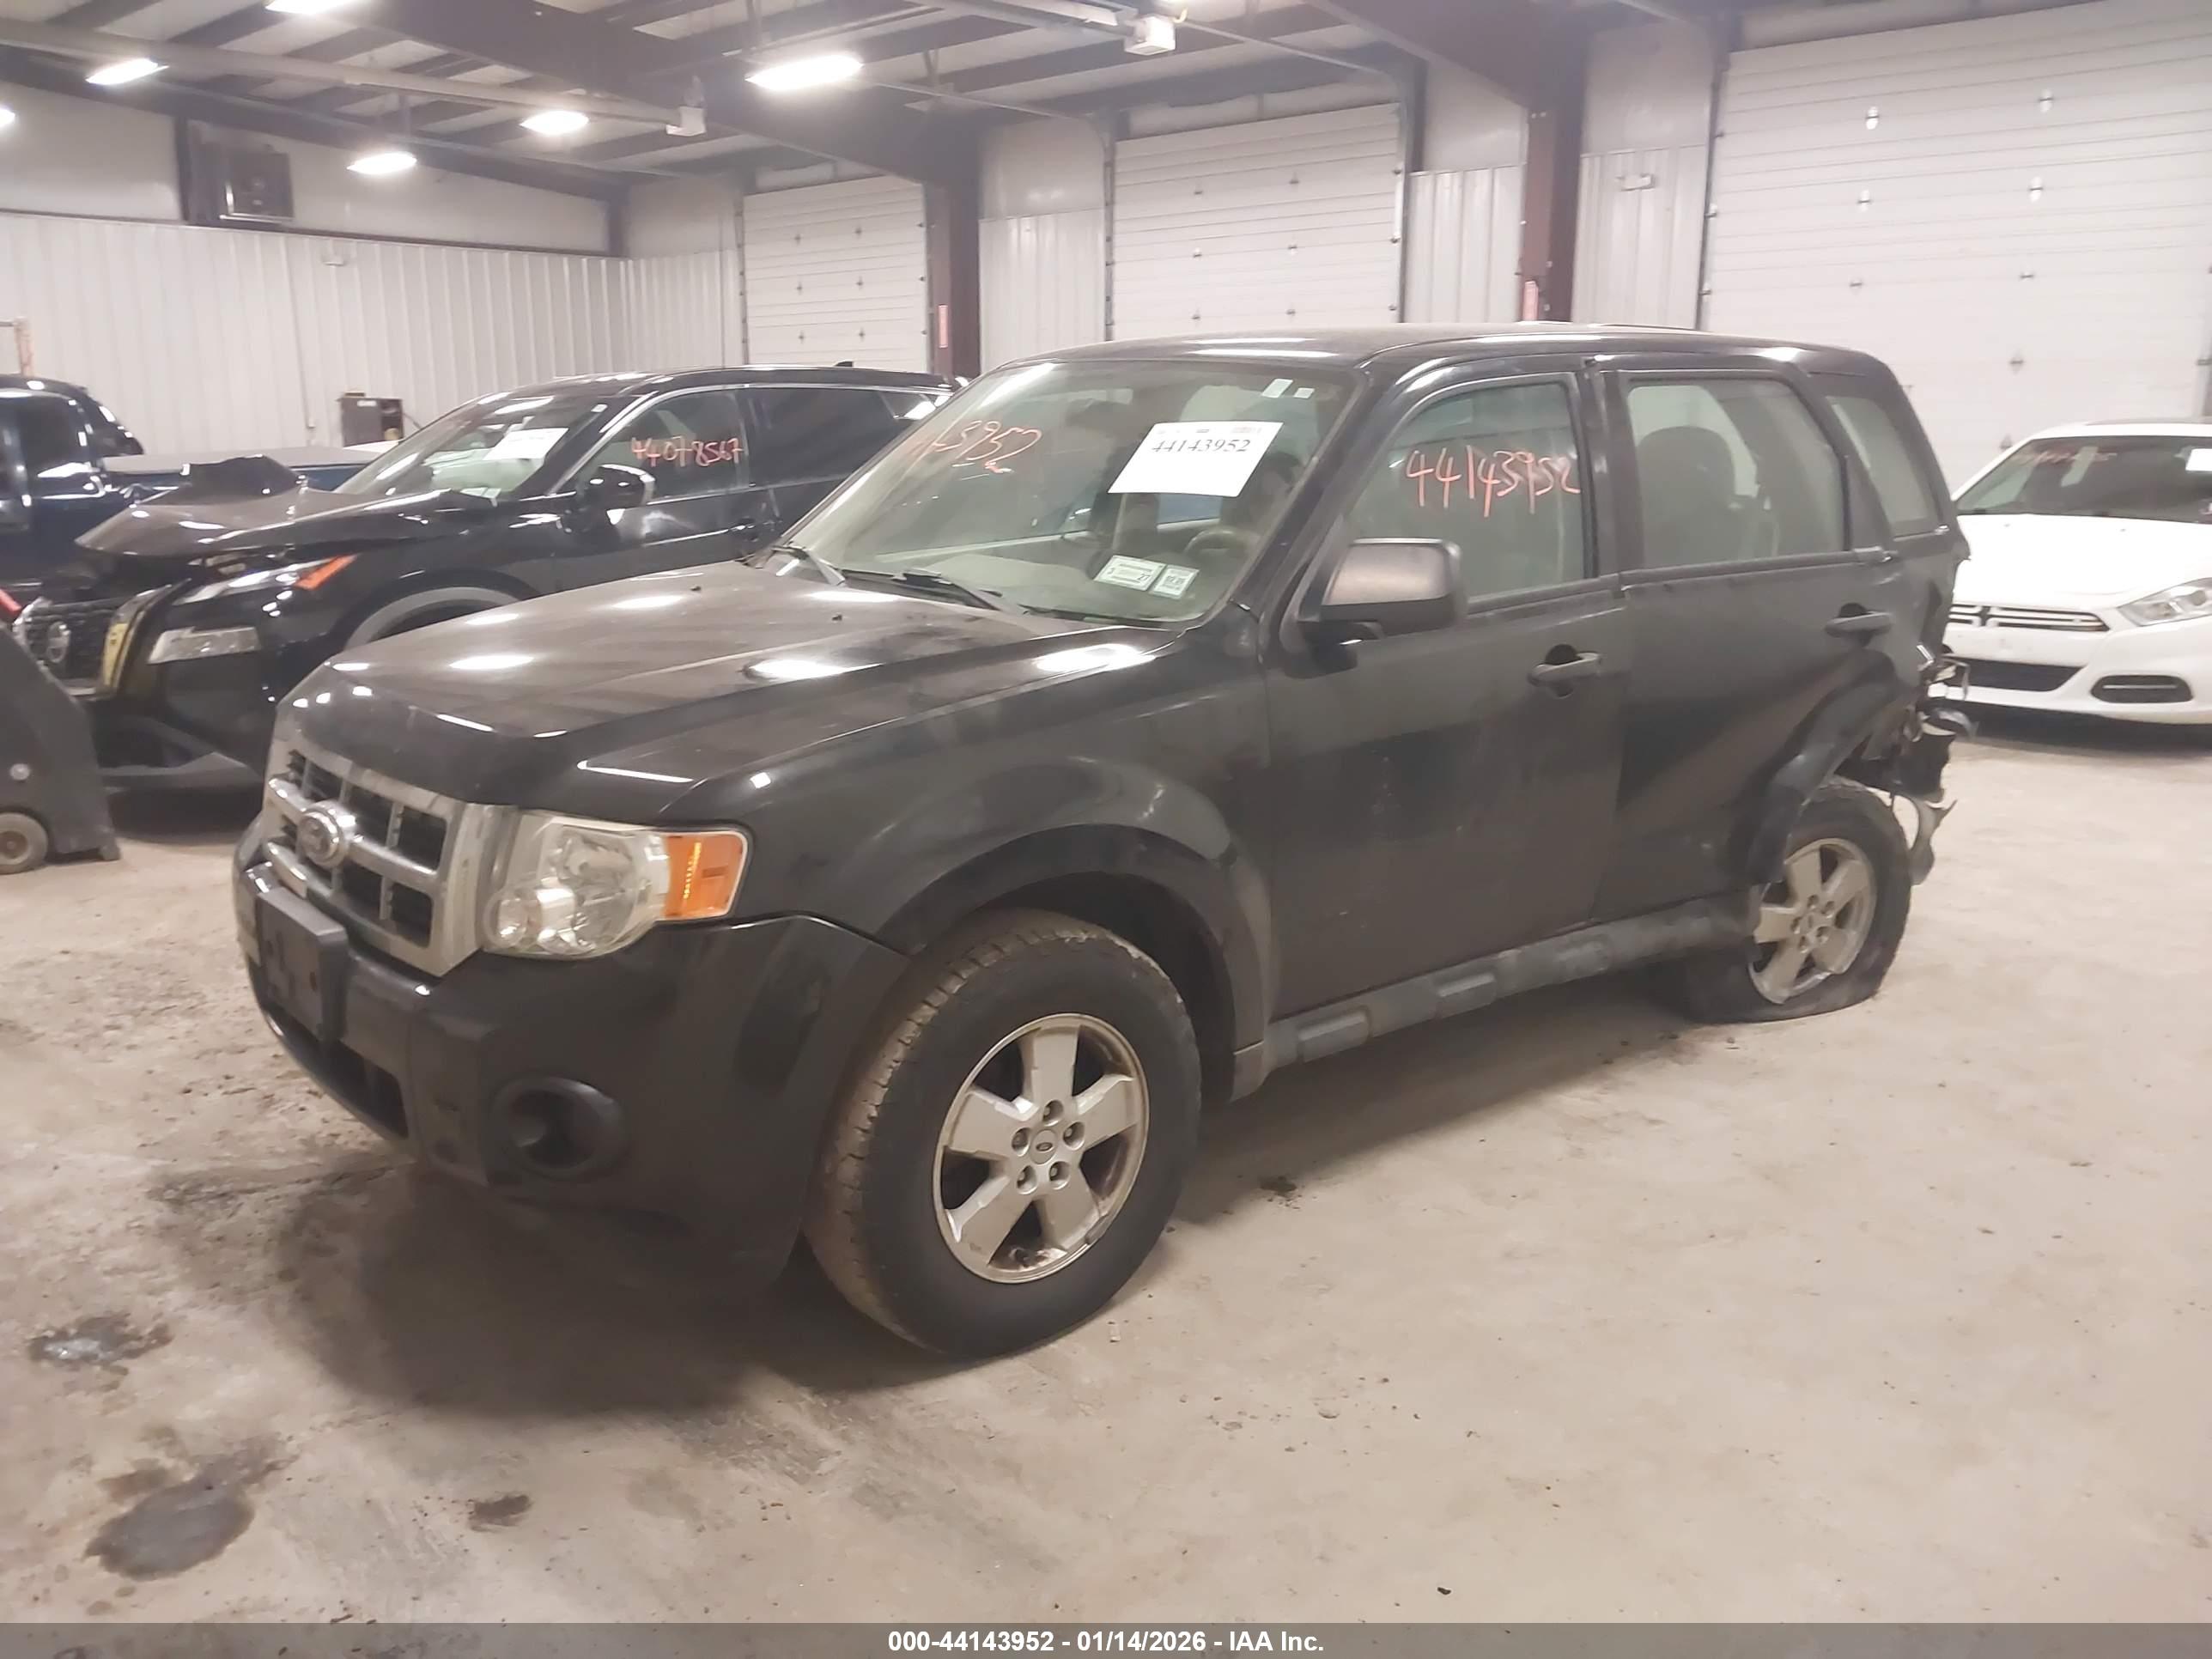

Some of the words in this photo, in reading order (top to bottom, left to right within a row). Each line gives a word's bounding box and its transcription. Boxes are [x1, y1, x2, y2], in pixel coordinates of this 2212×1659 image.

[631, 435, 744, 467] 44078567
[1152, 439, 1251, 453] 44143952
[1406, 445, 1581, 517] 44143952
